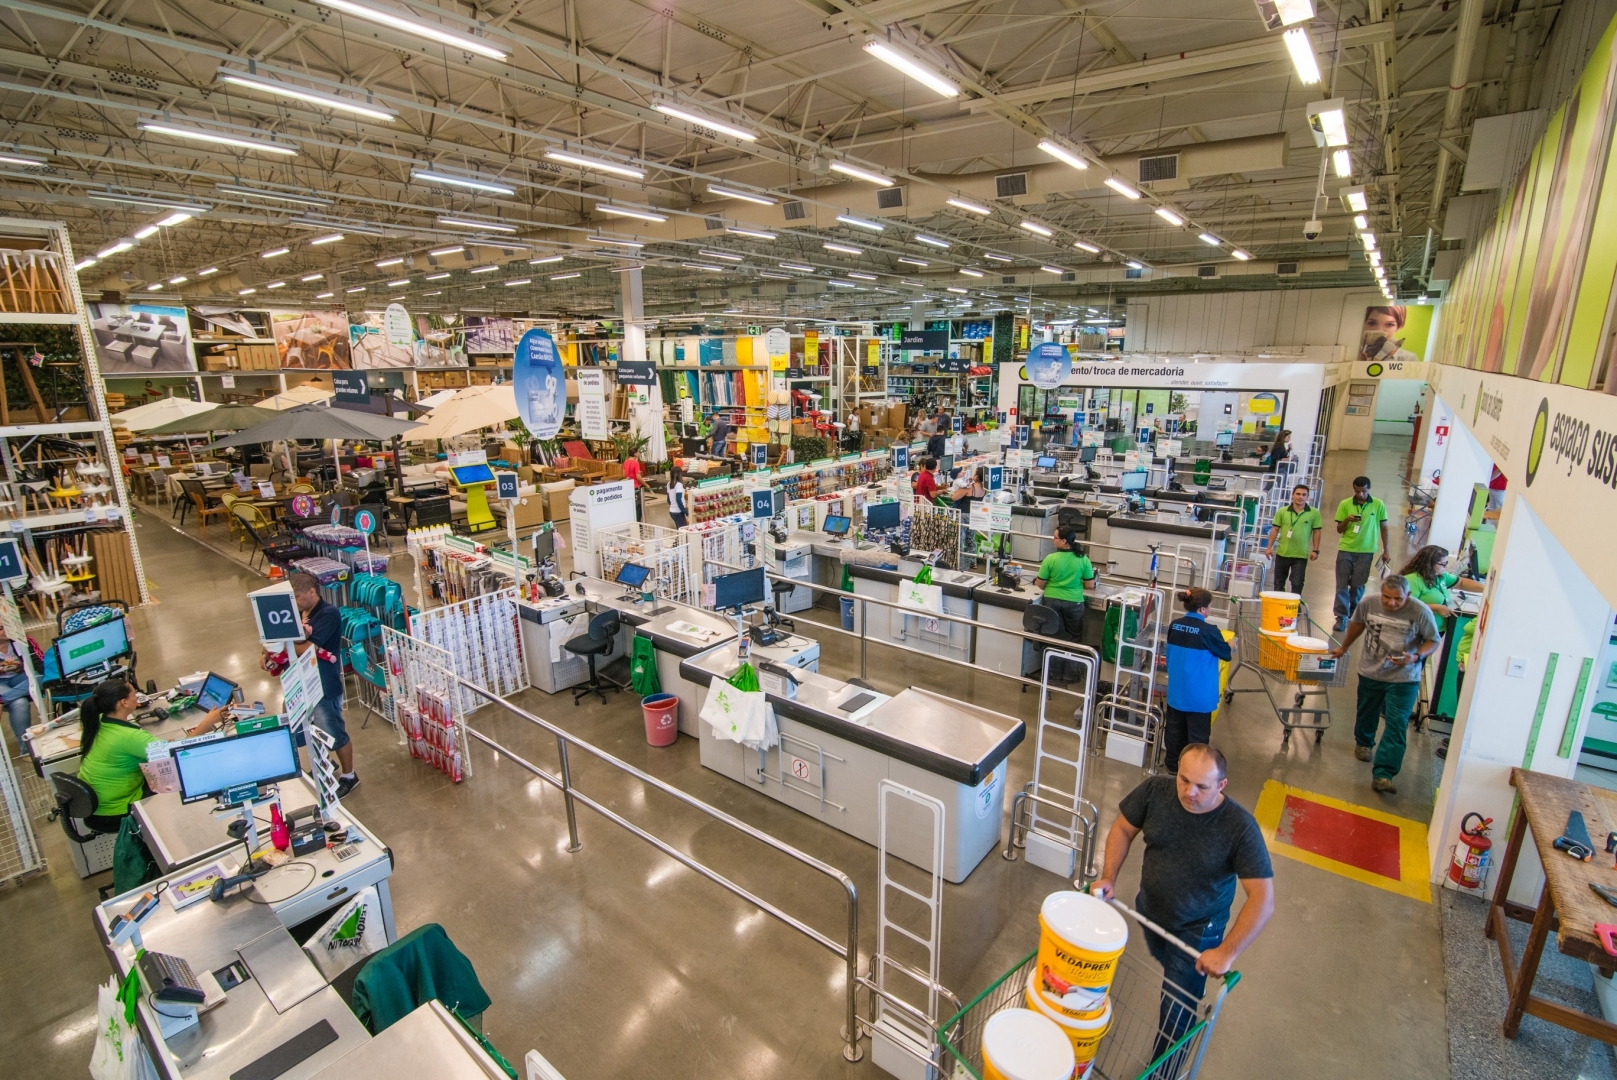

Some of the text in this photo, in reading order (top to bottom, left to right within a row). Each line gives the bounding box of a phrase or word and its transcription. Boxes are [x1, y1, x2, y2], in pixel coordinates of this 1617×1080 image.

[1070, 365, 1185, 376] ento/troca de mercadoria
[1388, 362, 1403, 371] WC
[1550, 412, 1590, 477] espaço
[991, 474, 1000, 482] 07
[501, 482, 514, 491] 03
[596, 485, 623, 495] pagamento
[604, 494, 623, 502] pedidos
[757, 499, 770, 509] 04
[0, 555, 10, 567] 1
[268, 609, 293, 625] 02
[1172, 622, 1200, 635] SECTOR
[181, 737, 198, 745] Clique
[202, 734, 217, 742] retire
[357, 904, 368, 938] LEROY
[1055, 948, 1112, 971] VEDAPREN
